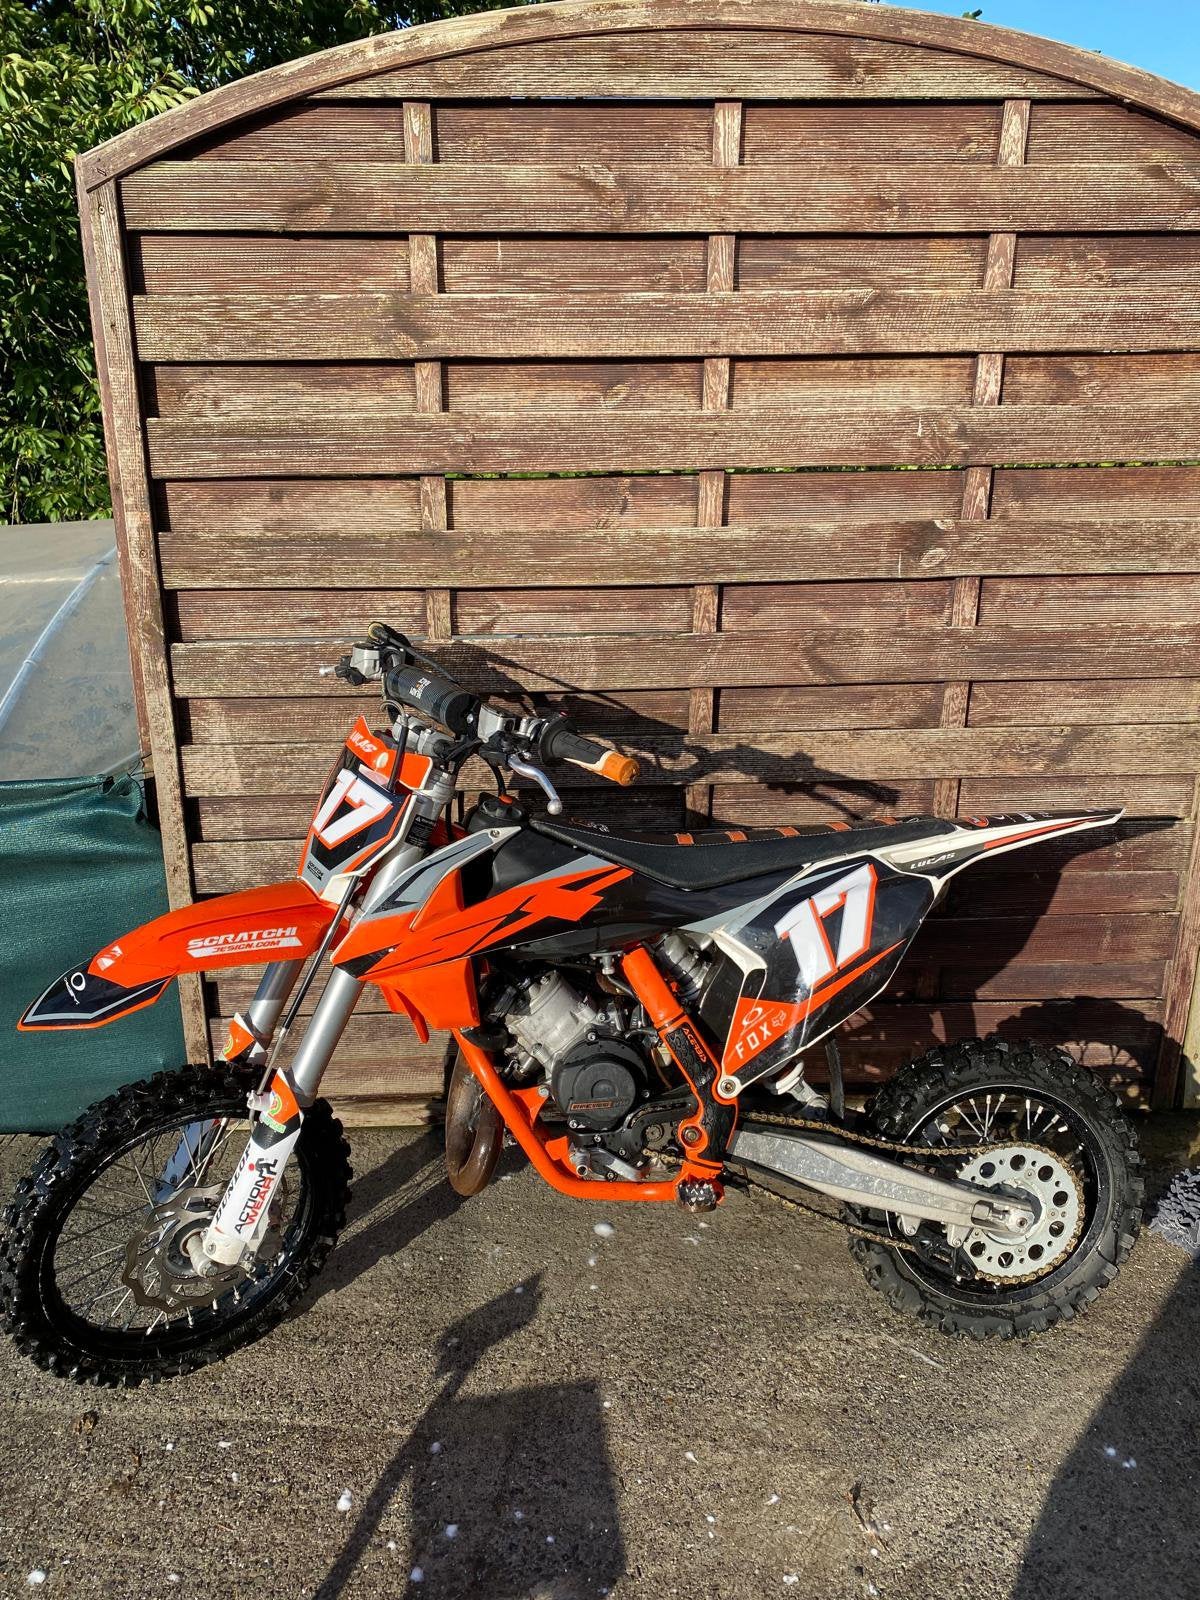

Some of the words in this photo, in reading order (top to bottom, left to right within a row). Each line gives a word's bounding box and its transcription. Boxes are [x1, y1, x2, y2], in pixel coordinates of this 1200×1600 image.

[312, 768, 394, 849] 17
[910, 852, 956, 870] LUCAS
[186, 926, 298, 949] SCRATCHI
[774, 862, 878, 990] 17
[735, 1021, 772, 1059] FOX
[235, 1173, 268, 1234] ACTION
[245, 1176, 275, 1227] WEAR
